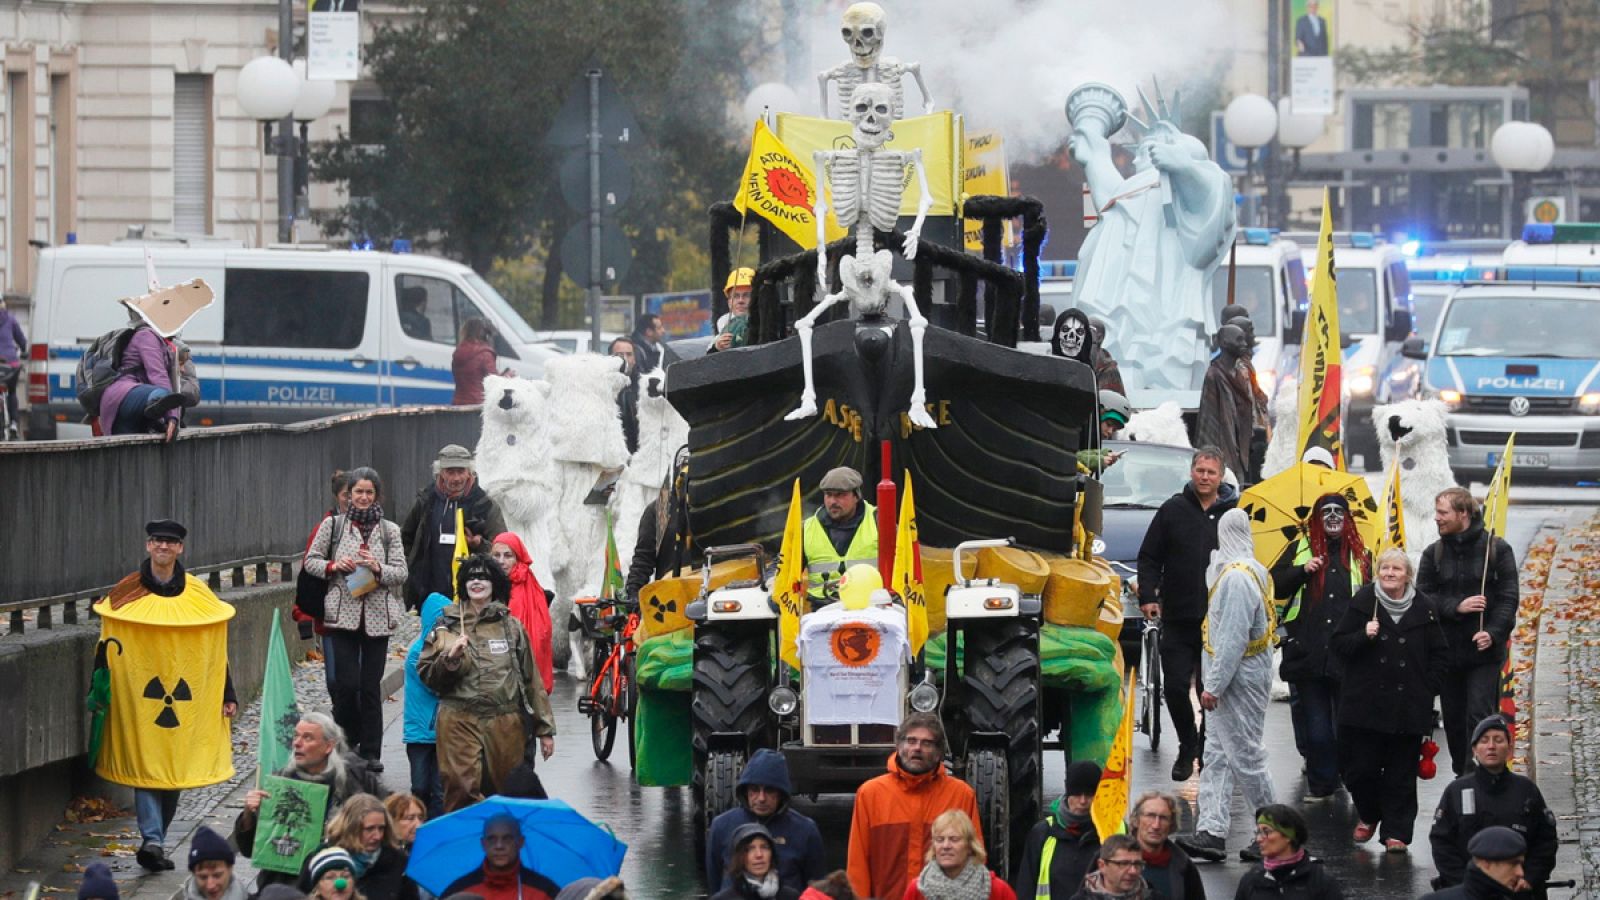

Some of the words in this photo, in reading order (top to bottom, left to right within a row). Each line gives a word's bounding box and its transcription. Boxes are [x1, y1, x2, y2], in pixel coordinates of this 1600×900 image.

[760, 199, 810, 224] DANKE
[267, 386, 336, 401] POLIZEI
[1477, 377, 1565, 391] POLIZEI
[780, 591, 800, 617] DAN
[903, 585, 926, 608] DAN
